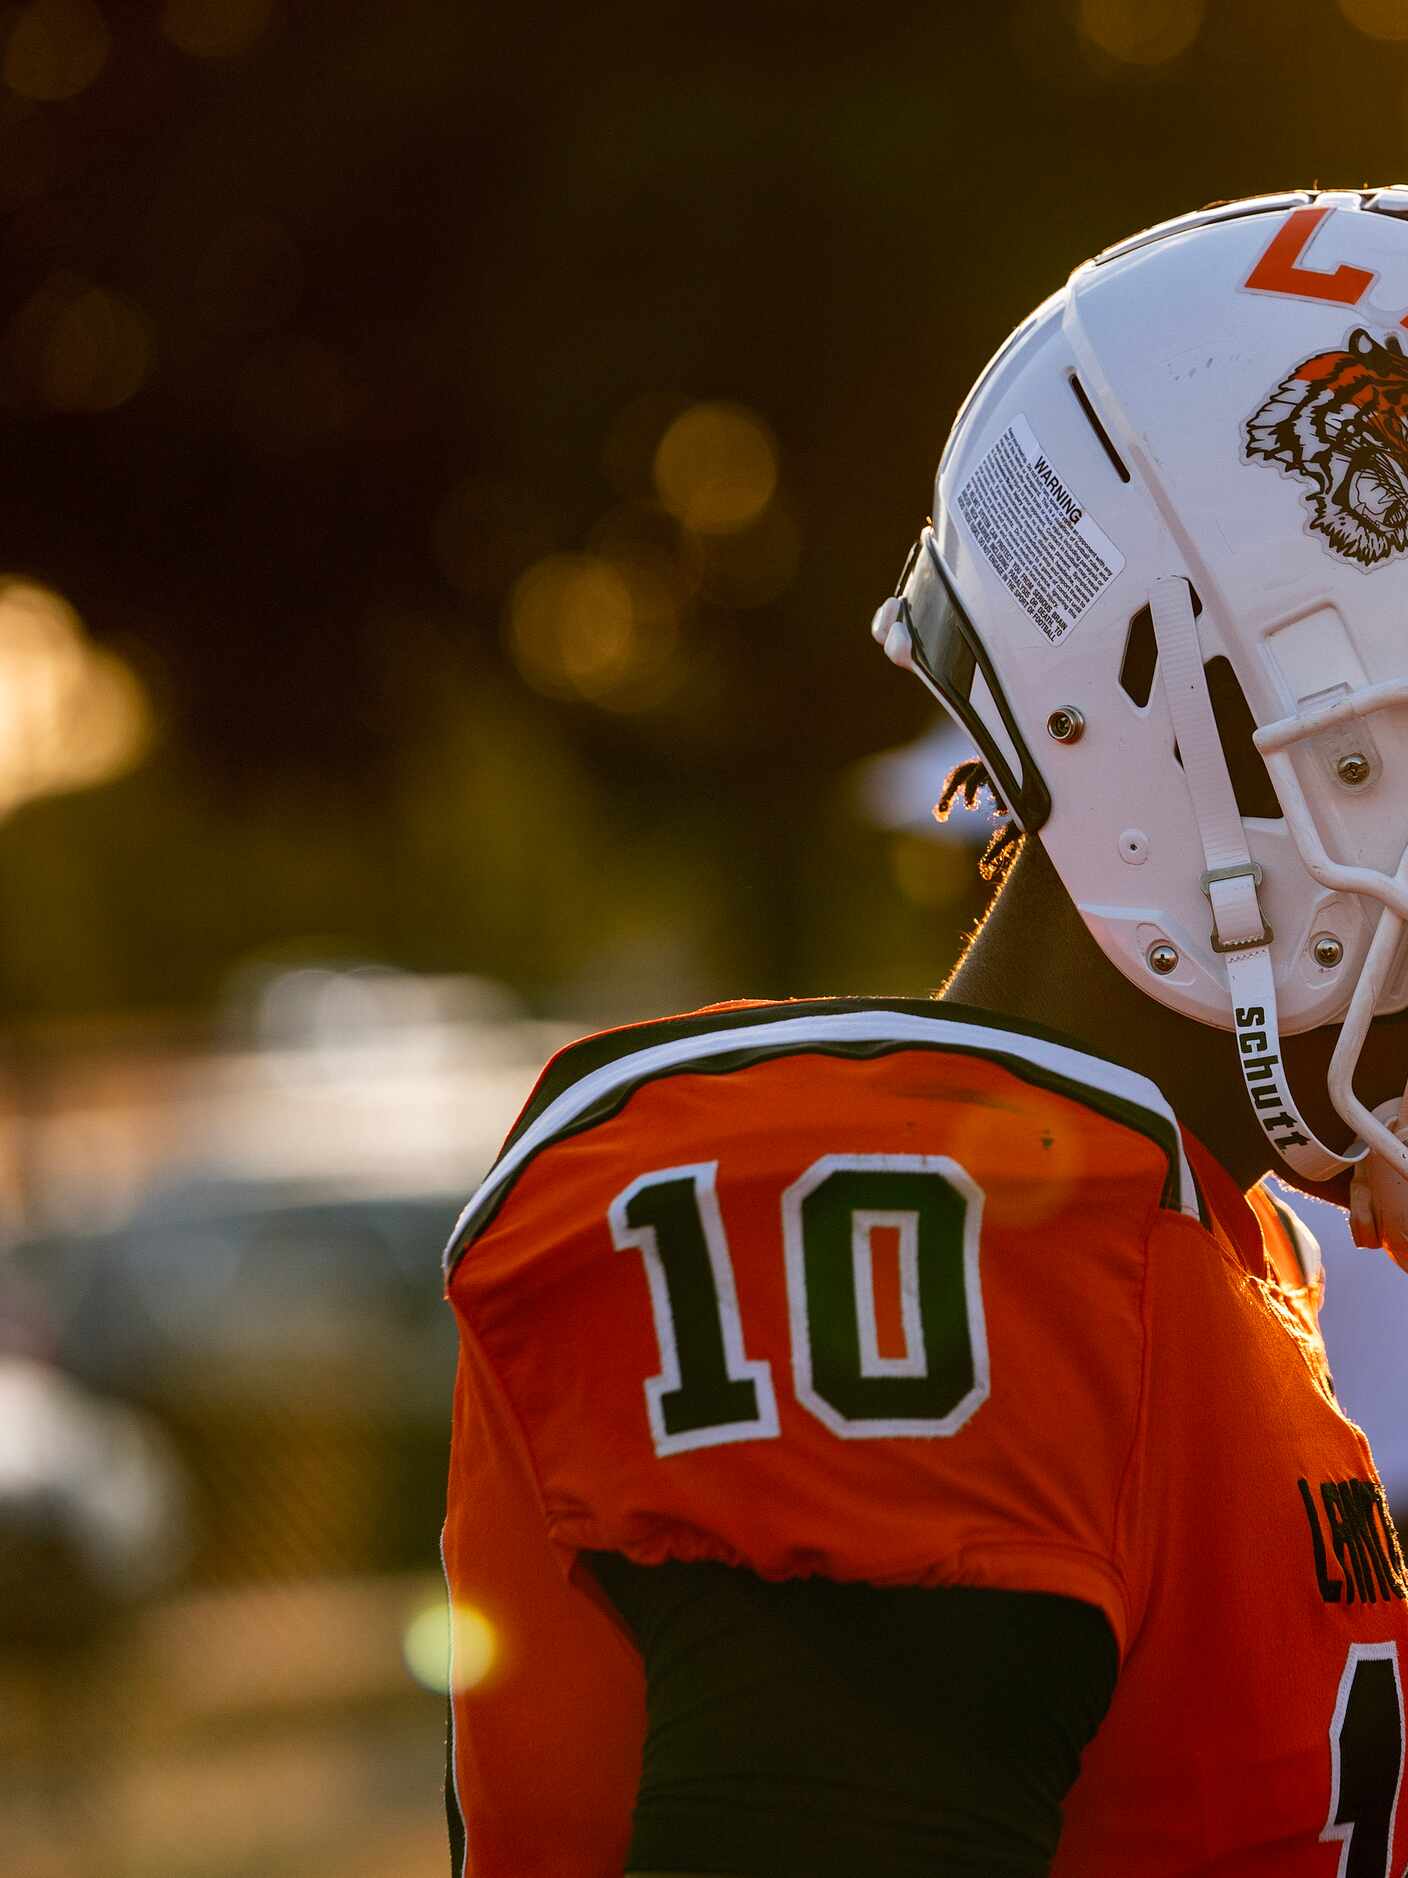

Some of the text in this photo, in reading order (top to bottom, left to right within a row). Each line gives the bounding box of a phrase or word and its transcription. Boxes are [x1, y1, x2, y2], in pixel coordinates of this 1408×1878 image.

[1033, 454, 1083, 525] WARNING
[1031, 611, 1057, 642] FOOTBALL
[1050, 610, 1068, 631] BRAIN
[1235, 1006, 1313, 1154] schutt
[607, 1153, 991, 1458] 10
